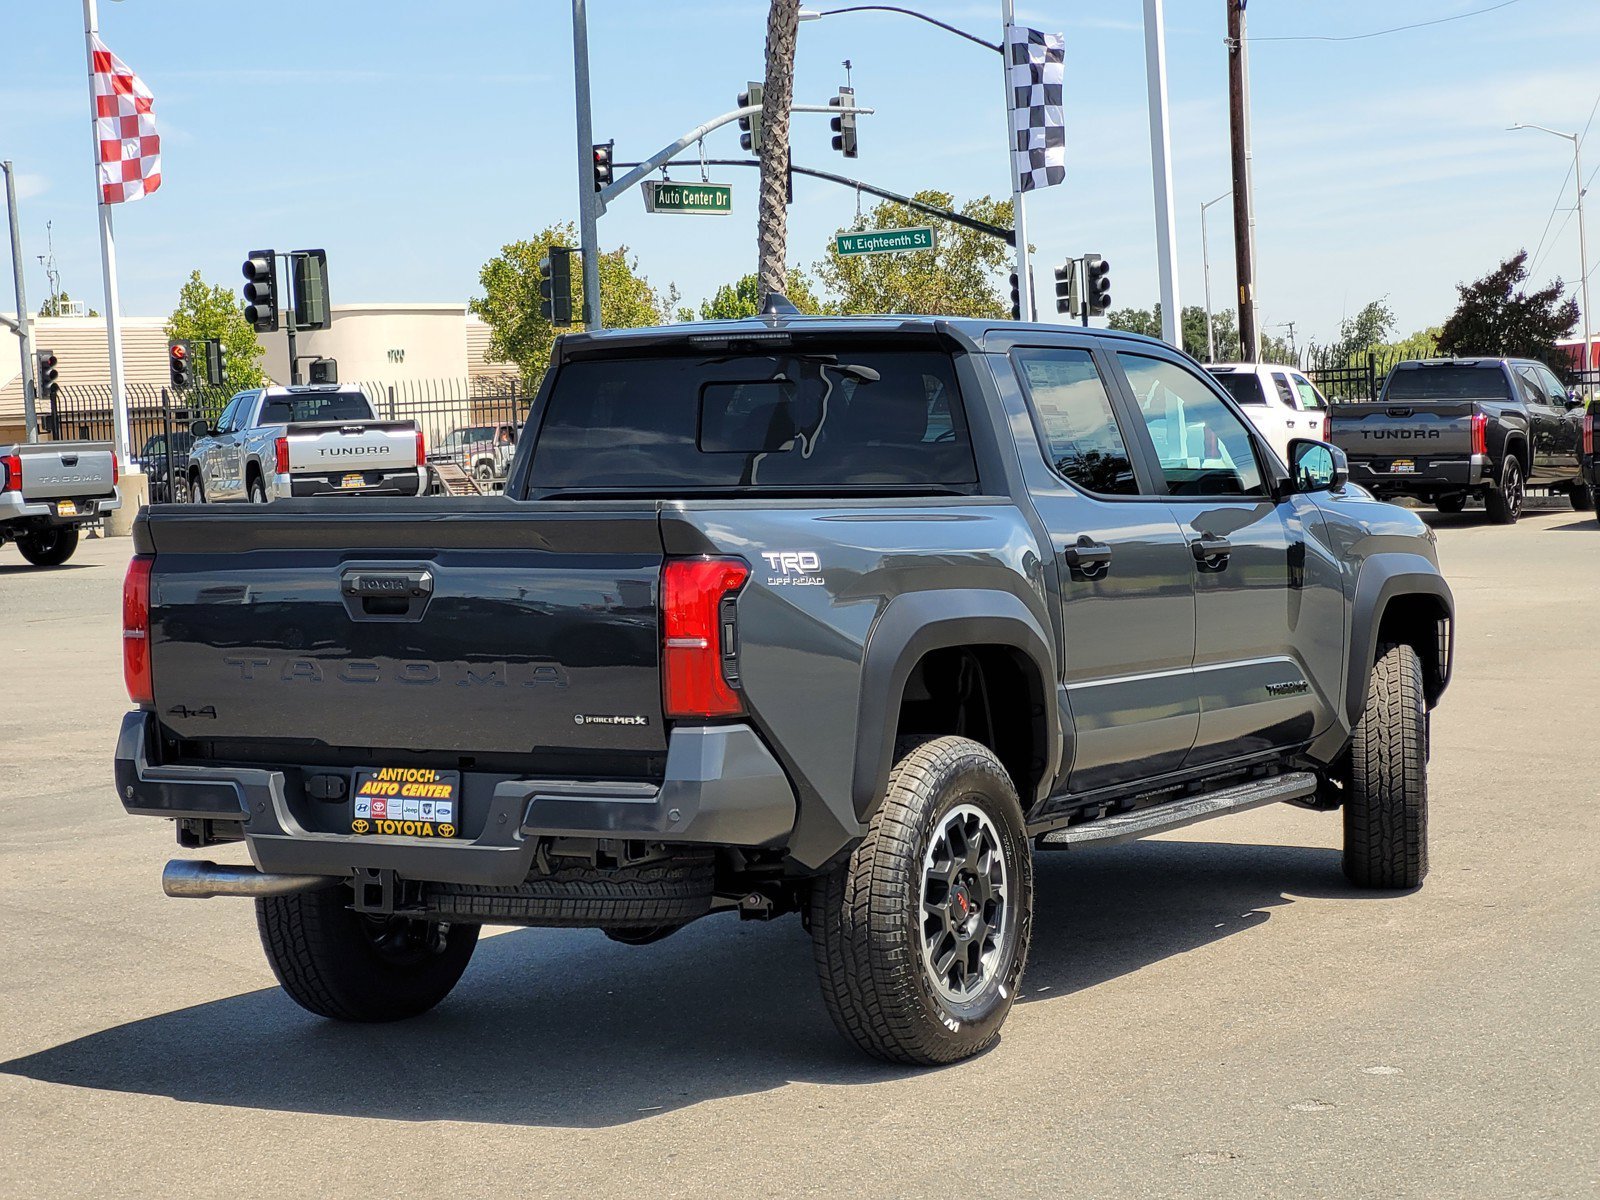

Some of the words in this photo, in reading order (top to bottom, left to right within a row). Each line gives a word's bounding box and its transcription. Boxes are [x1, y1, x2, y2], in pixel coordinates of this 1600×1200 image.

[658, 189, 680, 205] Auto
[682, 189, 714, 206] Center
[715, 192, 728, 207] Dr
[842, 239, 855, 250] W.
[856, 234, 912, 251] Eighteenth
[913, 233, 926, 245] St
[1361, 429, 1440, 440] TUNDRA
[318, 445, 390, 456] TUNDRA
[39, 474, 102, 484] TACOMA
[761, 552, 821, 575] TRD
[361, 580, 405, 590] TOYOTA
[767, 577, 790, 586] OFF
[792, 577, 825, 586] ROAD
[223, 656, 570, 688] TACOMA
[377, 768, 435, 783] ANTIOCH
[358, 781, 400, 796] AUTO
[401, 783, 453, 798] CENTER
[375, 820, 434, 836] TOYOTA
